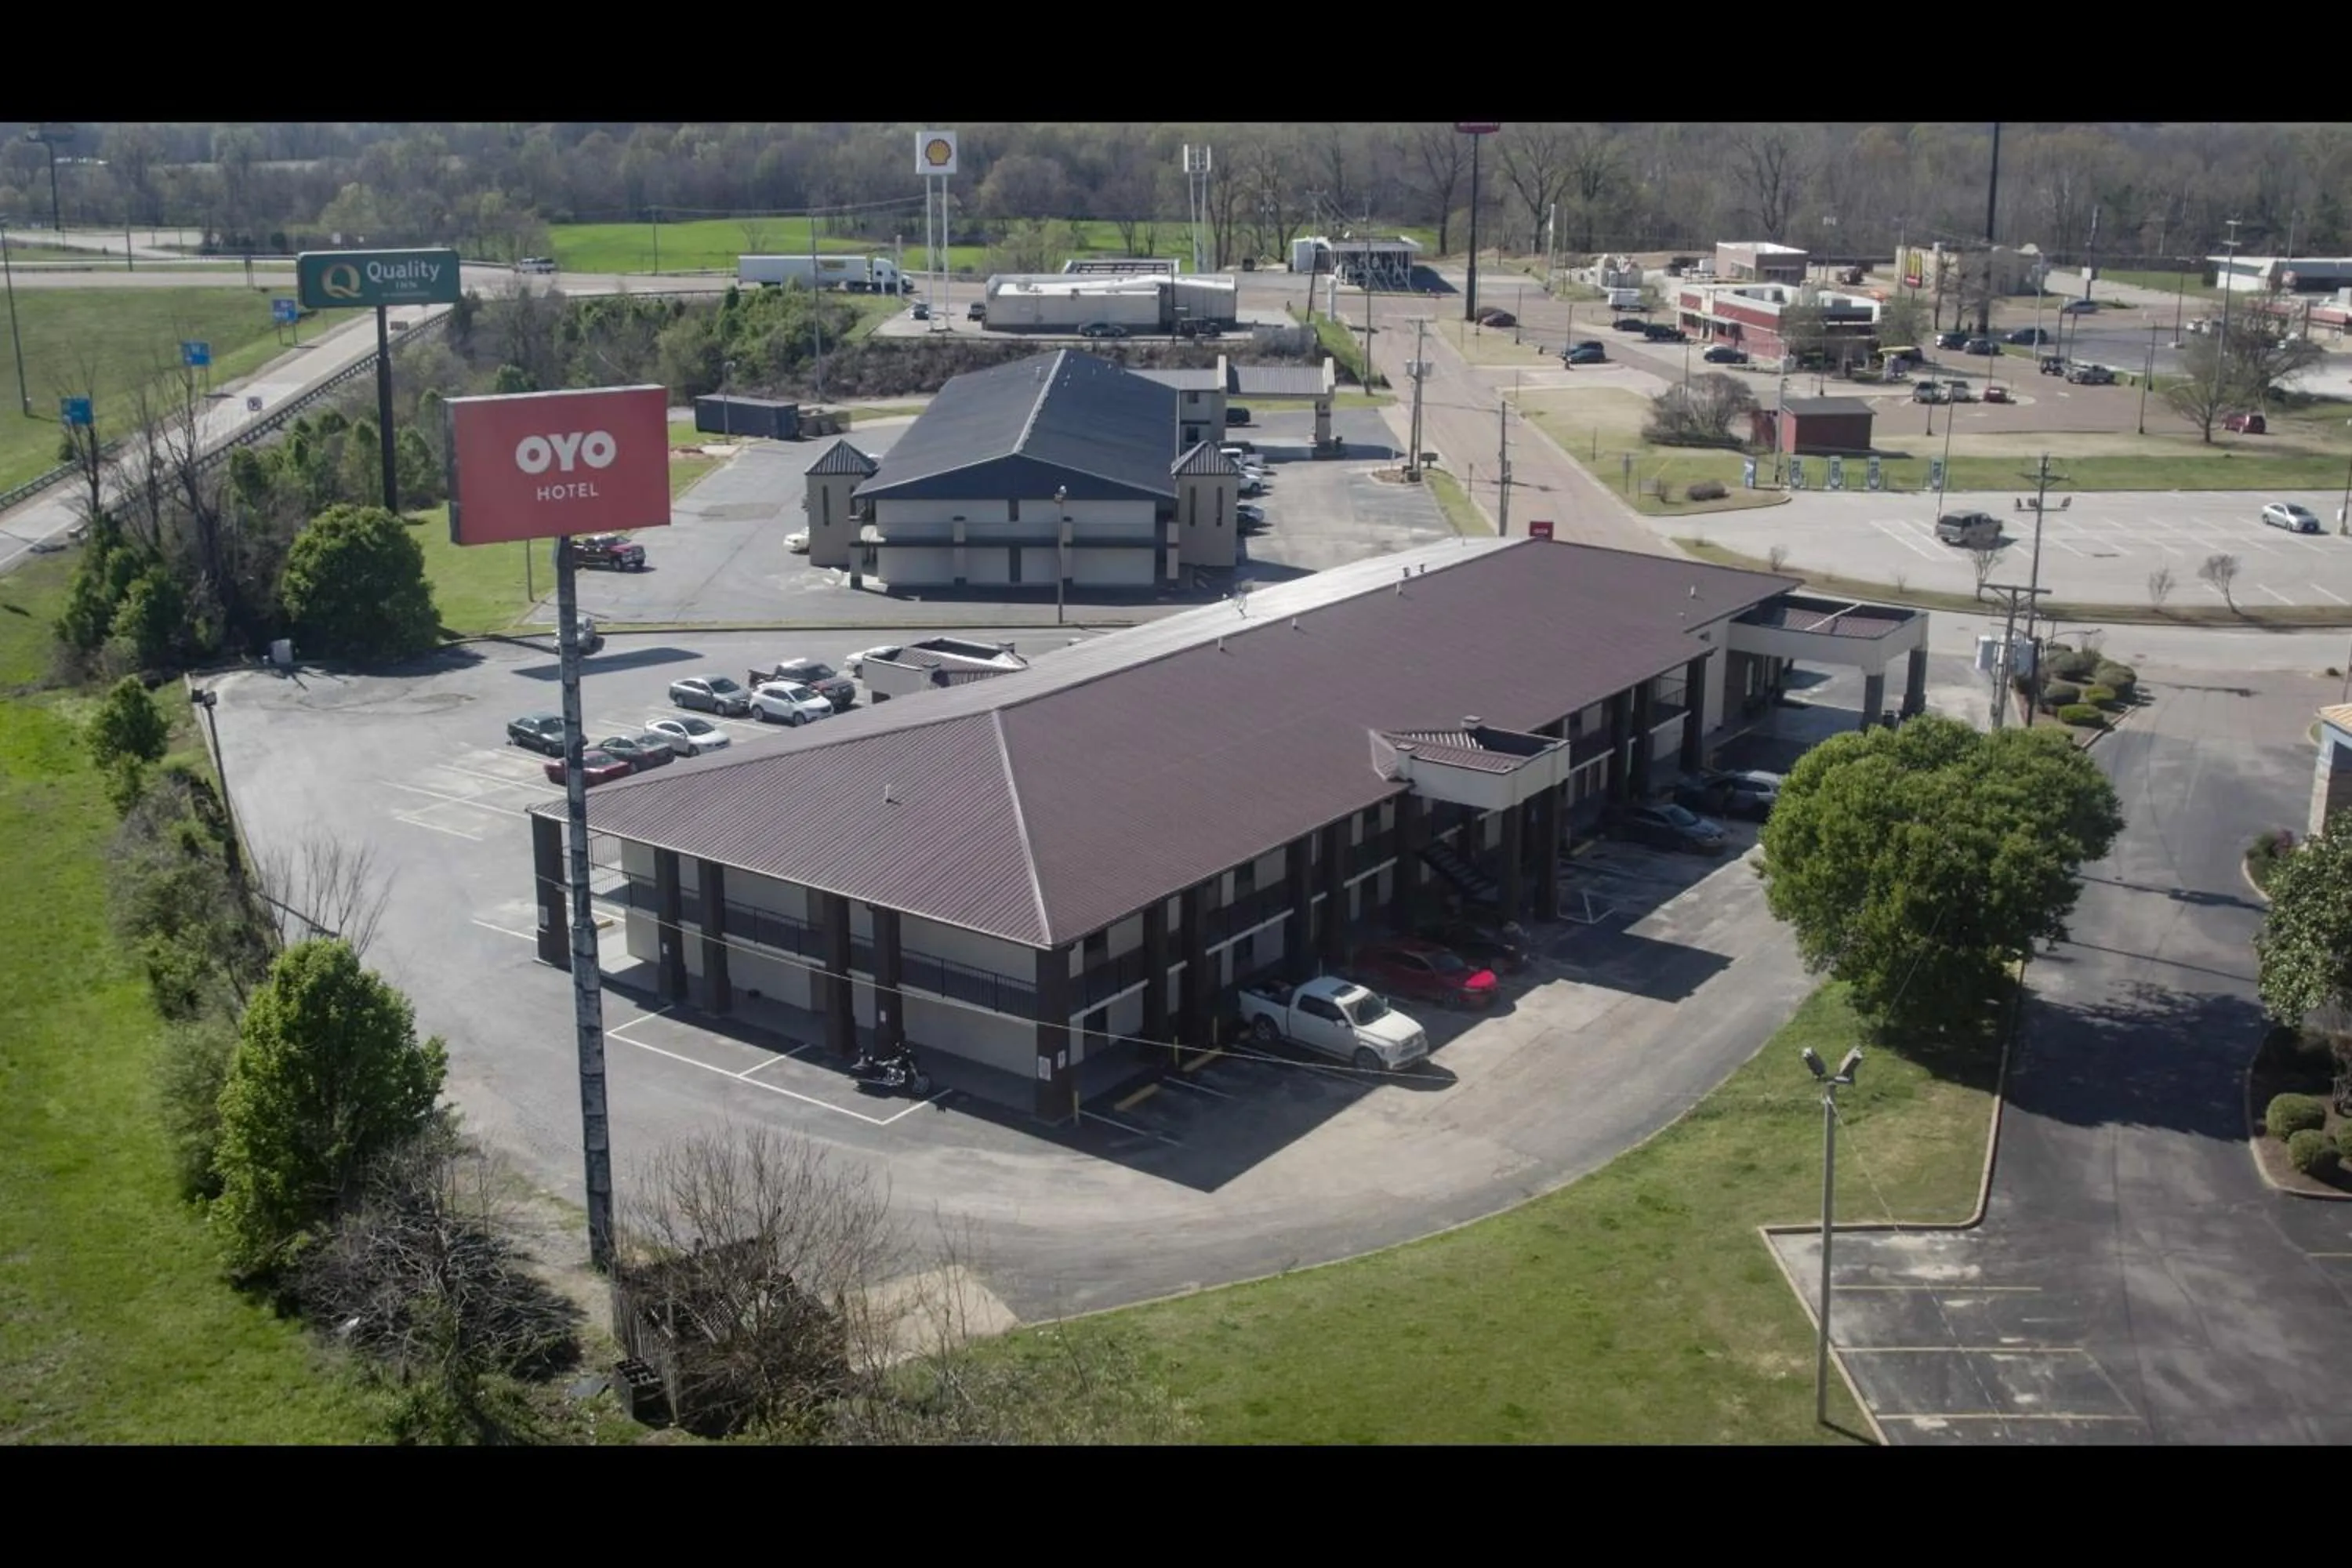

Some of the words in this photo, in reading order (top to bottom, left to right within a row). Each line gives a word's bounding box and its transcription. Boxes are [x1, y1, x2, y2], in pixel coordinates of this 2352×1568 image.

[366, 260, 440, 284] Quality
[515, 430, 616, 474] OYO
[536, 482, 599, 502] HOTEL
